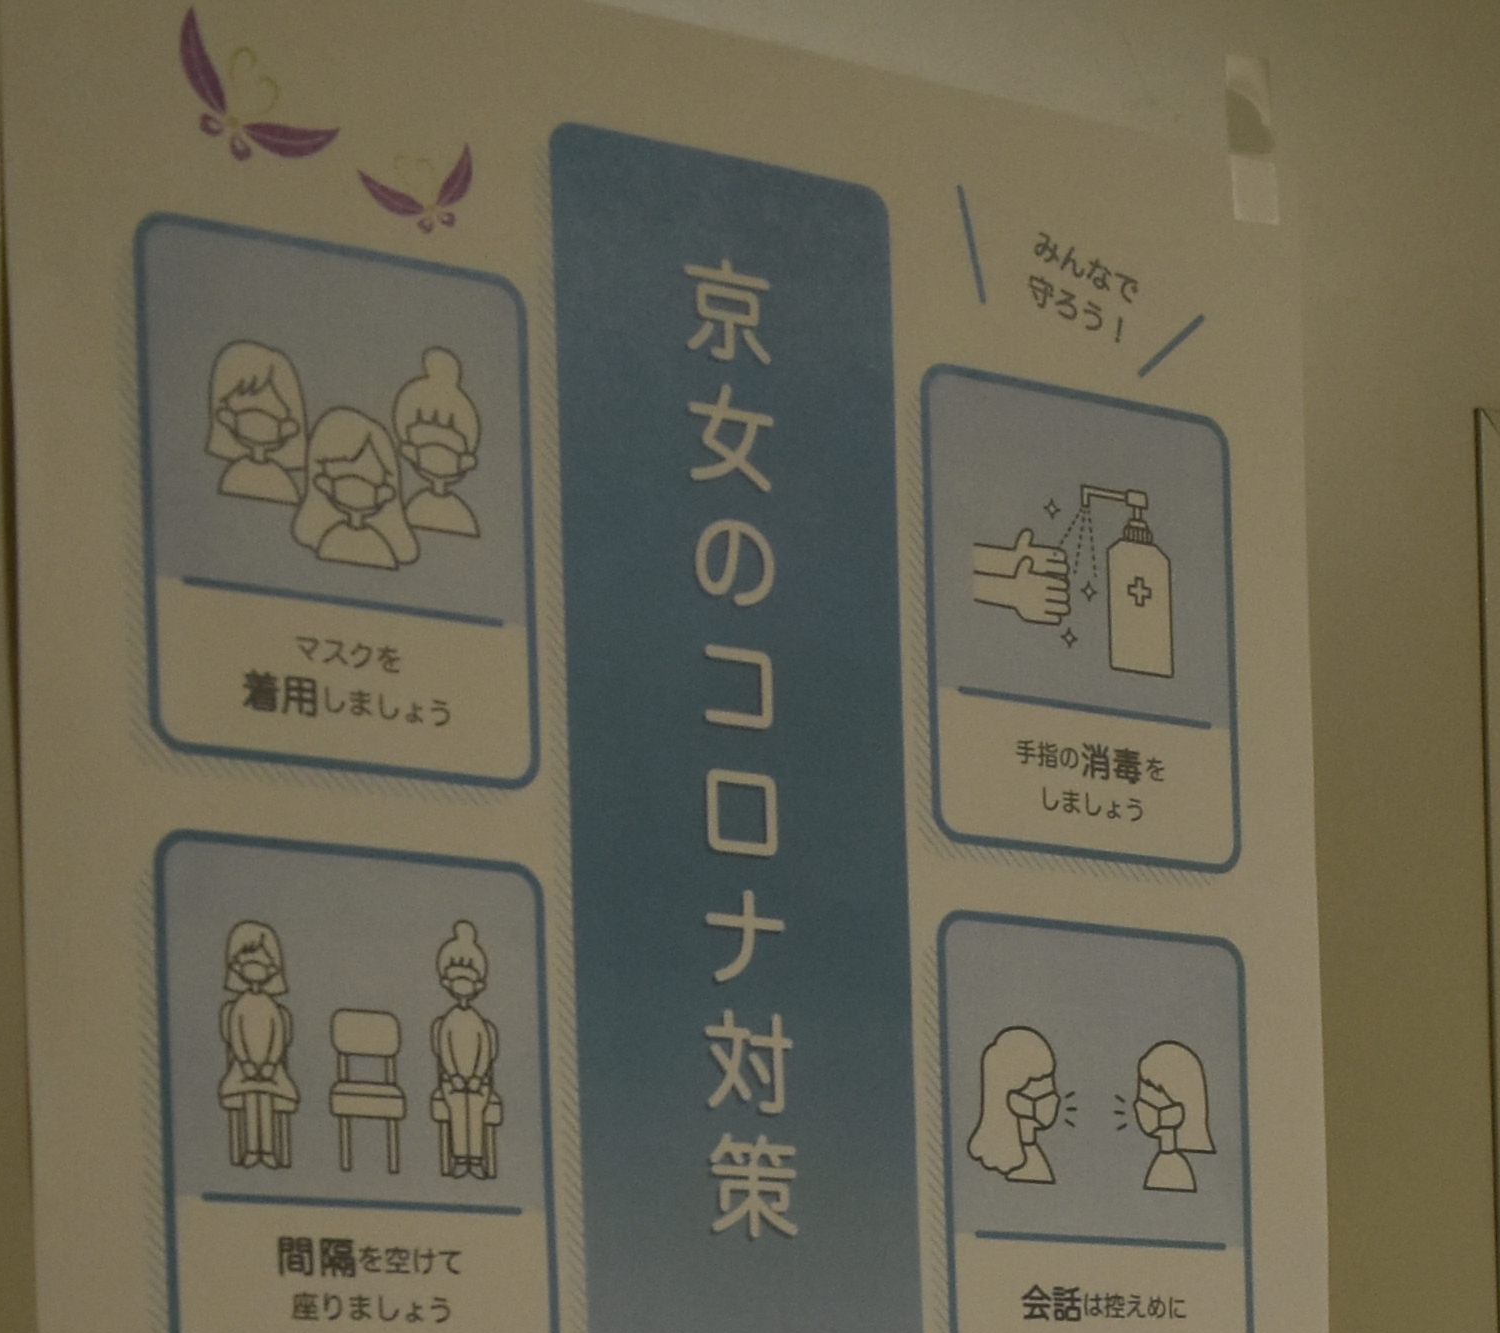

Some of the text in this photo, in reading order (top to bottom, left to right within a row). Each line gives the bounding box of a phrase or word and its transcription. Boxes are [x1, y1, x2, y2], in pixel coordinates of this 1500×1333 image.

[1033, 231, 1139, 304] みんなで
[295, 635, 401, 675] マスクを
[242, 669, 451, 728] 着用しましょう
[684, 259, 798, 1237] 京女のコロナ対策
[1016, 739, 1165, 786] 手指の消毒を
[1041, 786, 1144, 823] しましょう
[276, 1235, 462, 1278] 間隔を空けて
[291, 1291, 452, 1325] 座りましょう
[1020, 1283, 1187, 1323] 会話は控えめに
